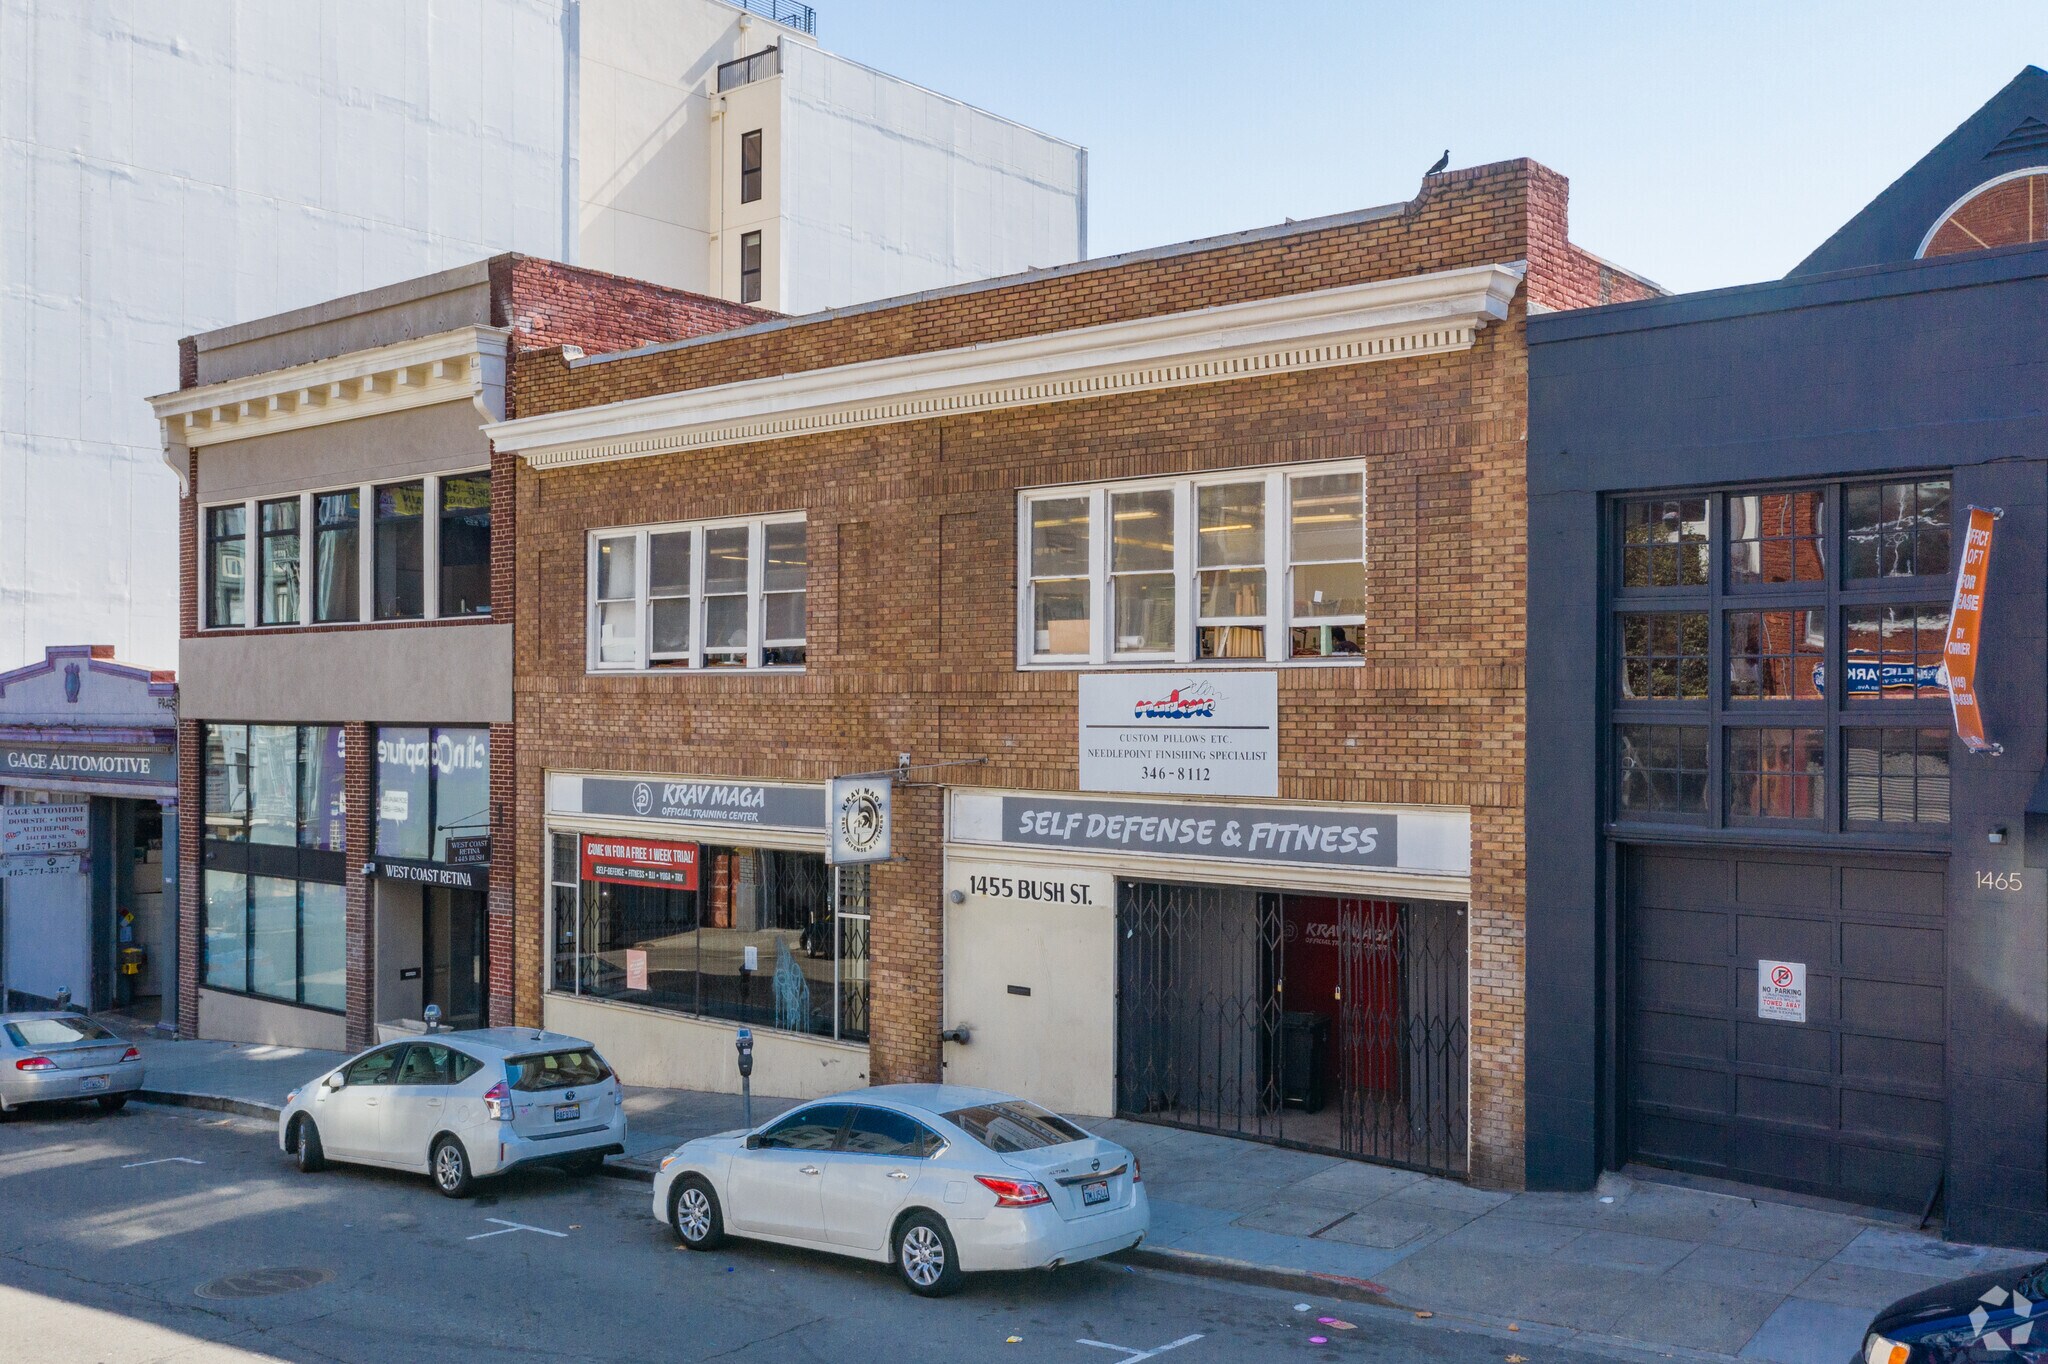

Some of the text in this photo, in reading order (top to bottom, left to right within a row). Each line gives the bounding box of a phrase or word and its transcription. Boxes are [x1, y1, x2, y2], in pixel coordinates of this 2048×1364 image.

[1956, 593, 1980, 611] EASE
[1956, 628, 1965, 639] BY
[1948, 642, 1971, 655] OWNER
[1119, 734, 1233, 744] CUSTOM PILLOWS ETC.
[1088, 748, 1268, 761] NEEDLEPOINT FINISHING SPECIALIST
[7, 752, 150, 774] GAGE AUTOMOTIVE
[1141, 766, 1211, 781] 346-8112
[662, 783, 765, 808] KRAV MAGA
[842, 788, 883, 811] KRAV MAGA
[7, 806, 85, 816] GAGE AUTOMOTIVE
[661, 806, 759, 822] OFFICIAL TRAINING CENTER
[1018, 810, 1379, 855] SELF DEFENSE & FITNESS
[15, 841, 78, 851] 415-771-1933
[451, 840, 488, 849] WEST COAST
[459, 847, 481, 855] RETINA
[844, 837, 867, 853] DEFENSE
[587, 843, 695, 864] COME IN FOR A FREE 1 WEEK TRIAL!
[385, 864, 472, 886] WEST COAST RETINA
[595, 866, 625, 877] SELF-DEFENSE
[628, 869, 645, 879] FITNESS
[659, 872, 671, 880] YOGA
[1976, 870, 2023, 891] 1465
[970, 875, 1092, 905] 1455 BUSH ST.
[1774, 987, 1802, 996] PARKING
[1763, 999, 1783, 1007] TOWED
